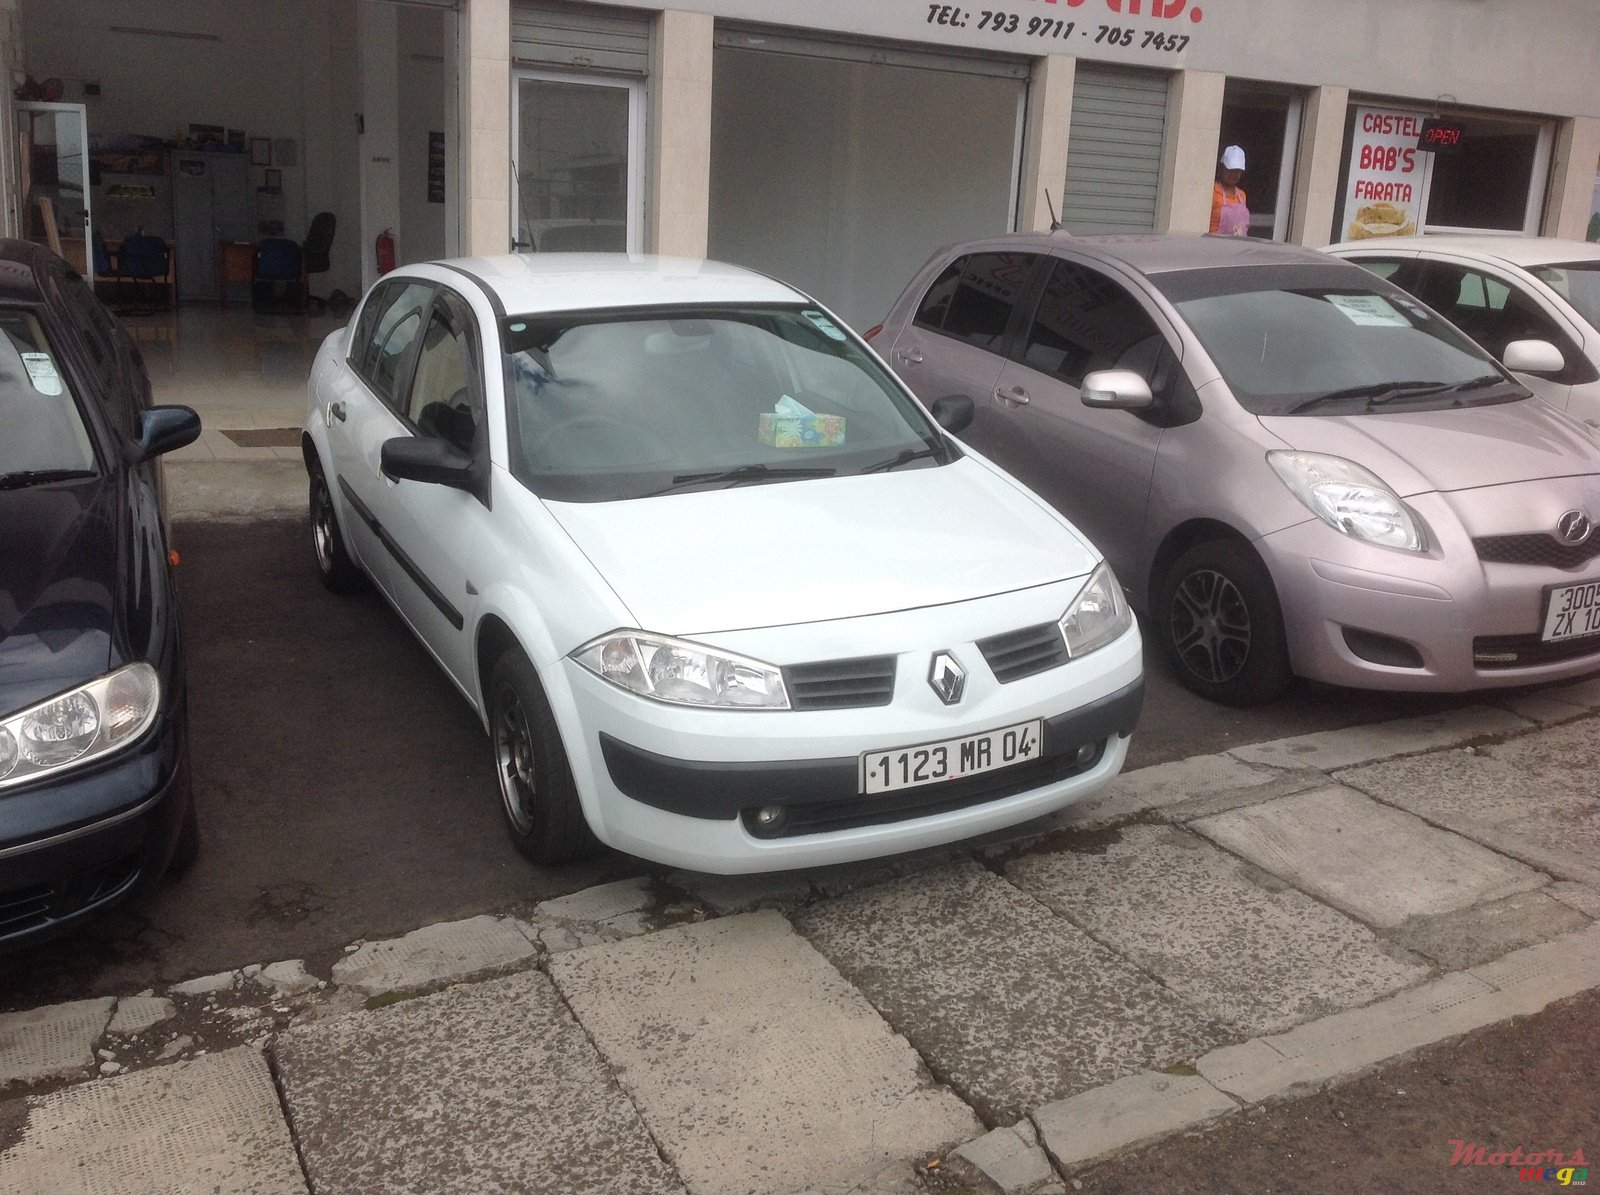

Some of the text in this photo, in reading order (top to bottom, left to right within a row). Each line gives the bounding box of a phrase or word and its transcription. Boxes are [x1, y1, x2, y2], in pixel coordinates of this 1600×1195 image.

[927, 4, 970, 28] TEL:
[977, 10, 1019, 33] 793
[1026, 16, 1075, 40] 9711
[1094, 25, 1136, 47] 705
[1141, 30, 1190, 53] 7457
[1363, 112, 1421, 137] CASTEL
[1425, 127, 1461, 145] OPEN
[1359, 144, 1417, 173] BAB'S
[1355, 180, 1412, 203] FARATA
[1552, 611, 1577, 637] ZX
[878, 727, 1032, 787] 1123 MR 04
